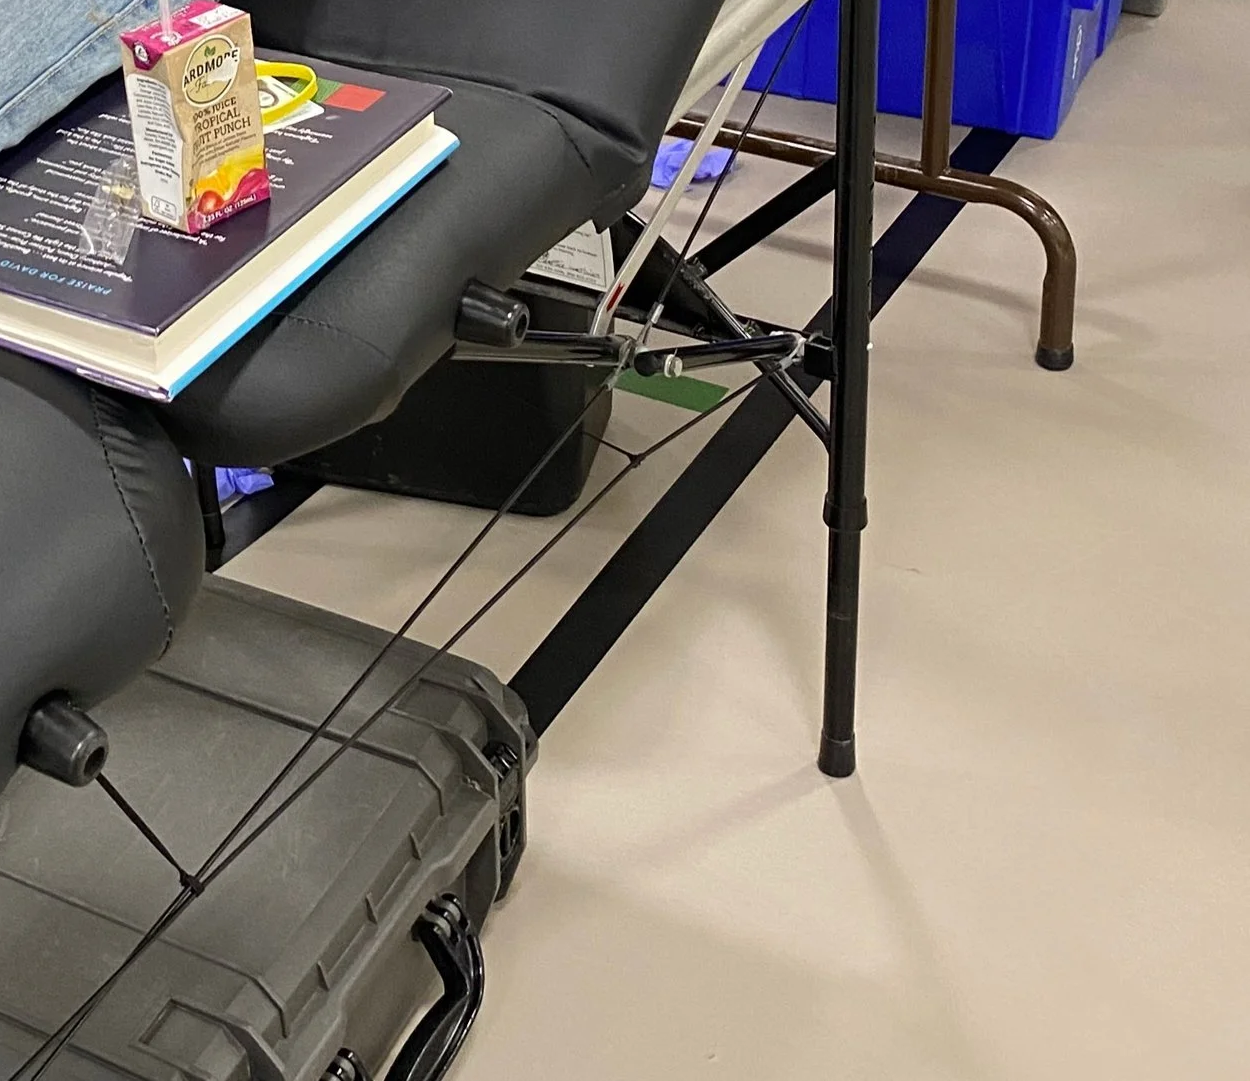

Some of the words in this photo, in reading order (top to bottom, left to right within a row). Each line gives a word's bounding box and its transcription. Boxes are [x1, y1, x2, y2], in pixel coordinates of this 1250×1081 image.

[212, 96, 236, 114] JUICE
[194, 107, 240, 133] ROPICAL
[214, 116, 251, 139] PUNCH
[0, 260, 39, 276] DAVID
[40, 271, 66, 283] FOR
[66, 279, 112, 295] PRAISE
